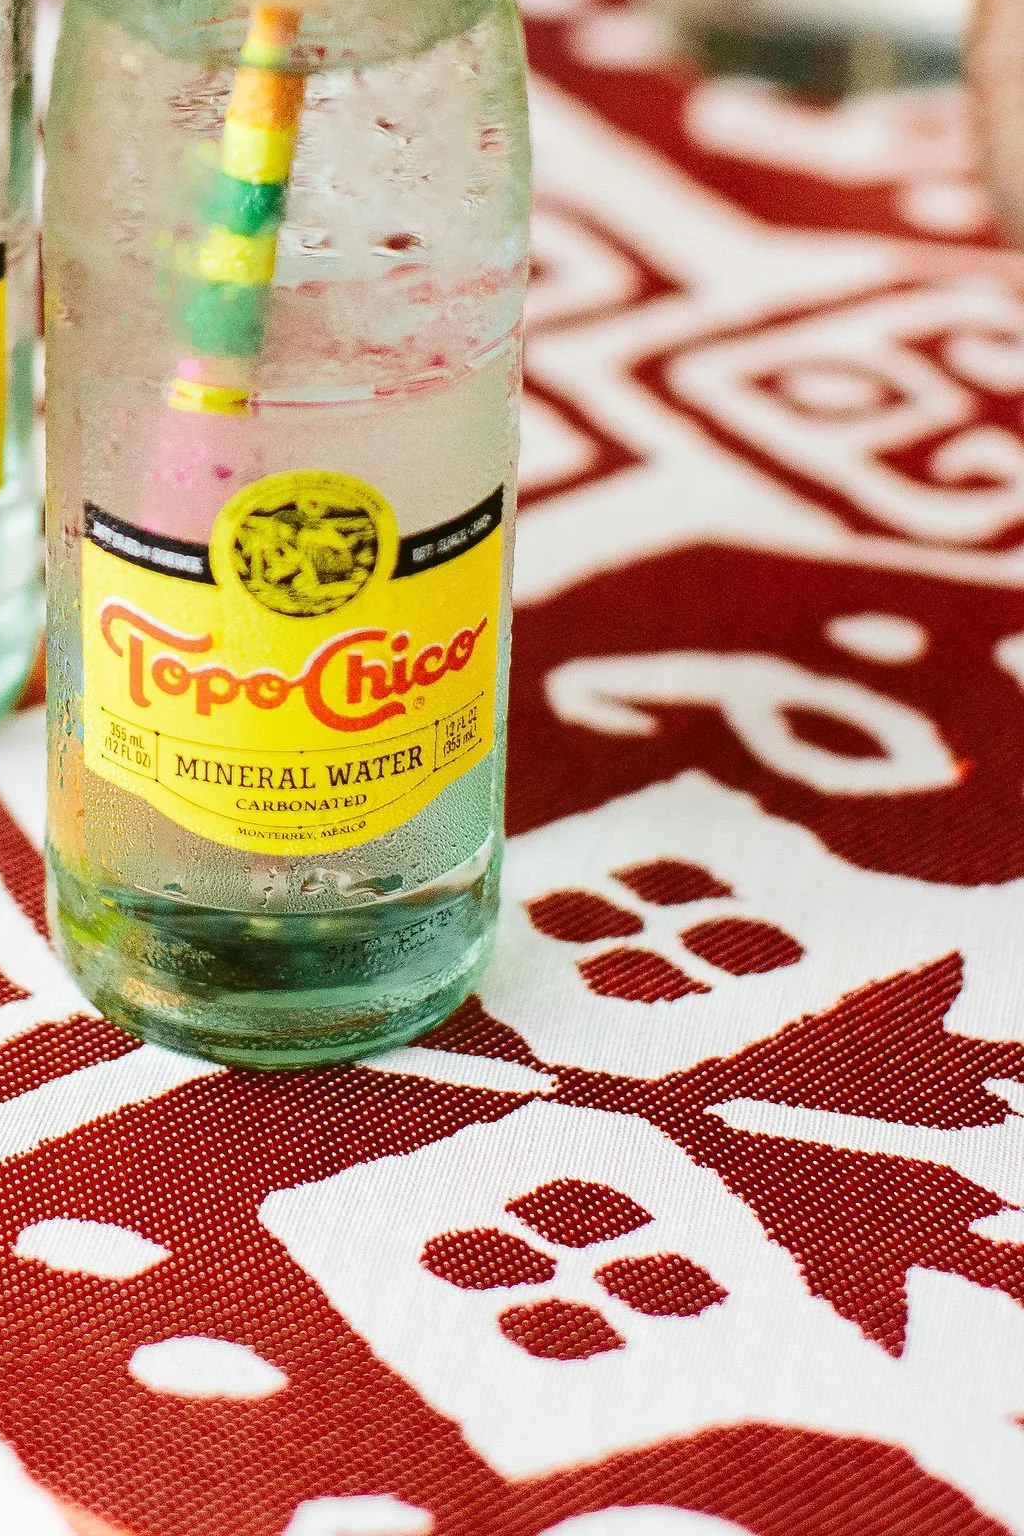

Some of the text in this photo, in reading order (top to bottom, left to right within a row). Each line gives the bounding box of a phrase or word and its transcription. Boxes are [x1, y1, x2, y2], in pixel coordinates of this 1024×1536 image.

[99, 596, 488, 733] Topo Chico
[110, 721, 145, 750] 355 mL
[121, 744, 133, 761] FL
[174, 745, 424, 790] MINERAL WATER
[235, 793, 368, 812] CARBONATED
[235, 826, 317, 841] MONTERREY,
